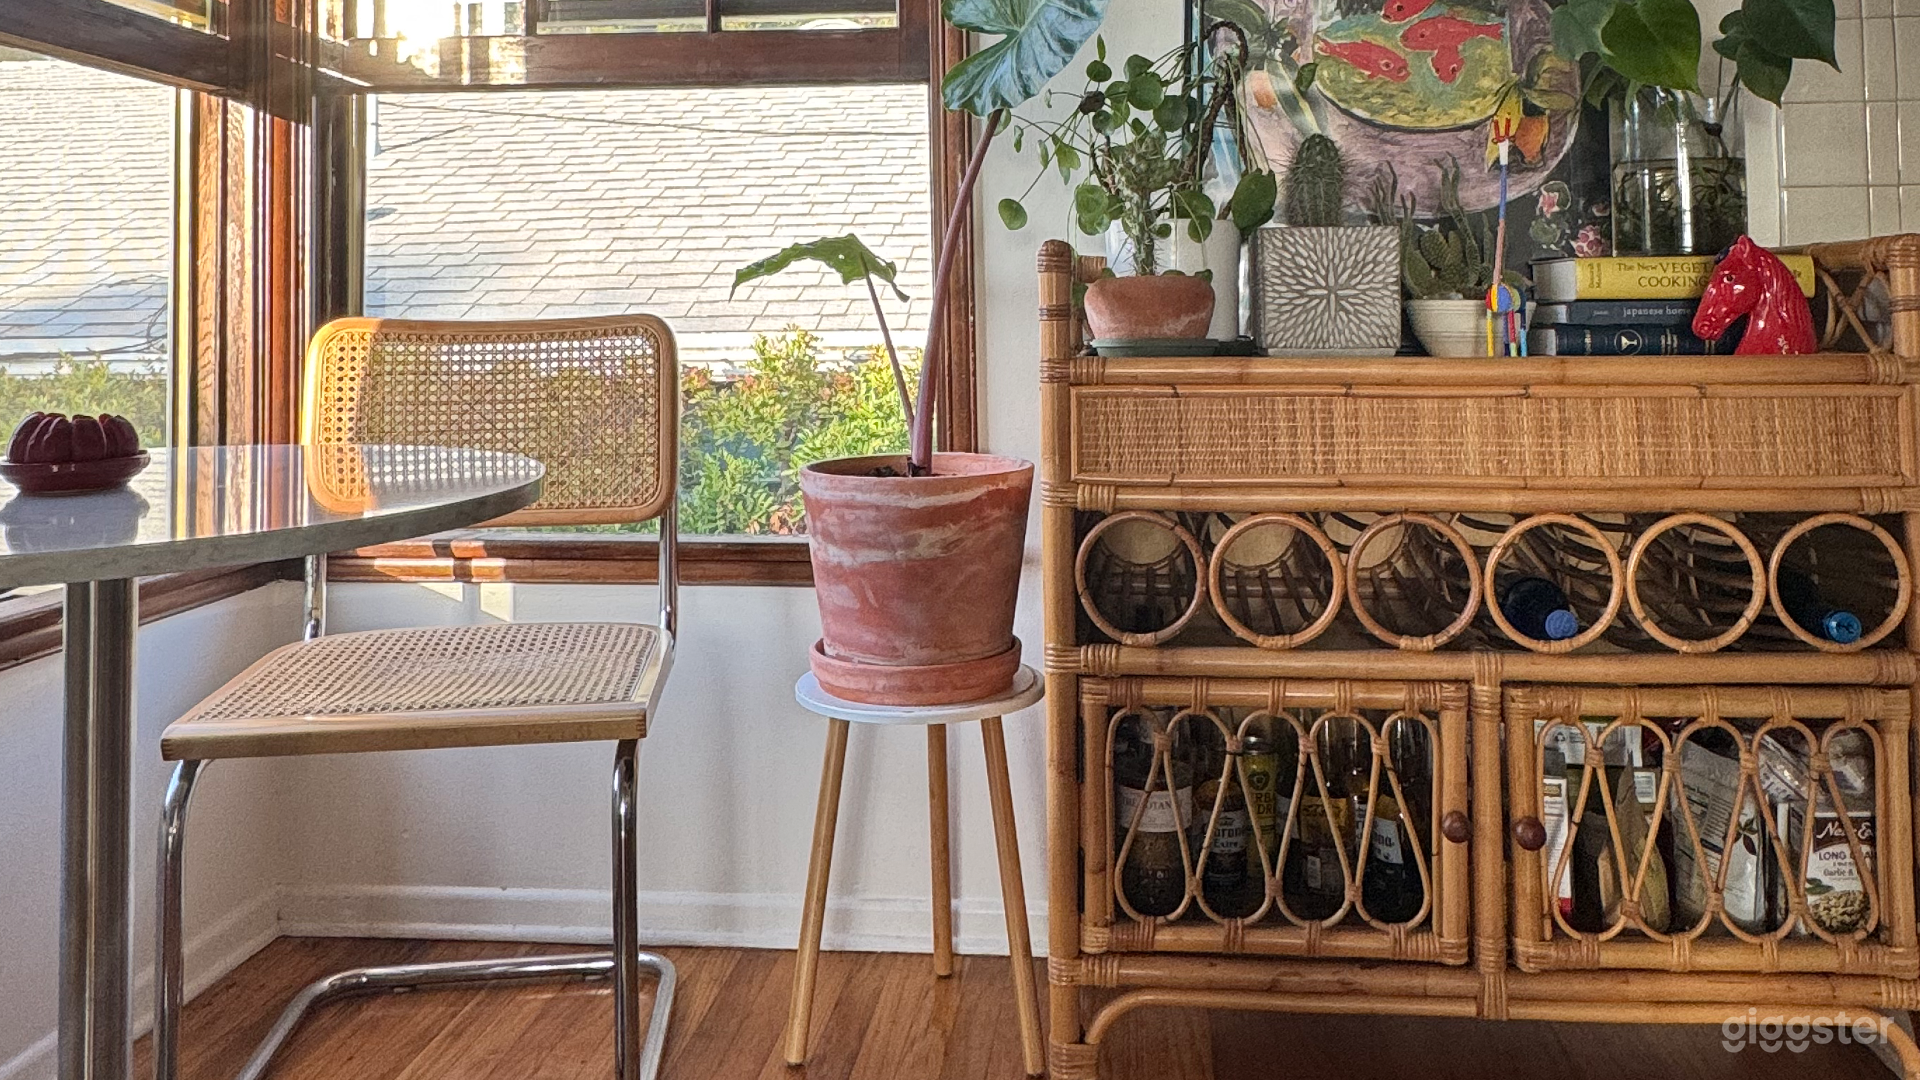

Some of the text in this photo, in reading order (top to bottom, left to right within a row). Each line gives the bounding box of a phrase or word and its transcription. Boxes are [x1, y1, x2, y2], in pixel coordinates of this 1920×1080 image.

[1616, 262, 1635, 271] The
[1637, 262, 1657, 271] New
[1638, 275, 1709, 288] COOKING
[1622, 307, 1663, 317] japanese
[1818, 851, 1847, 860] LONG
